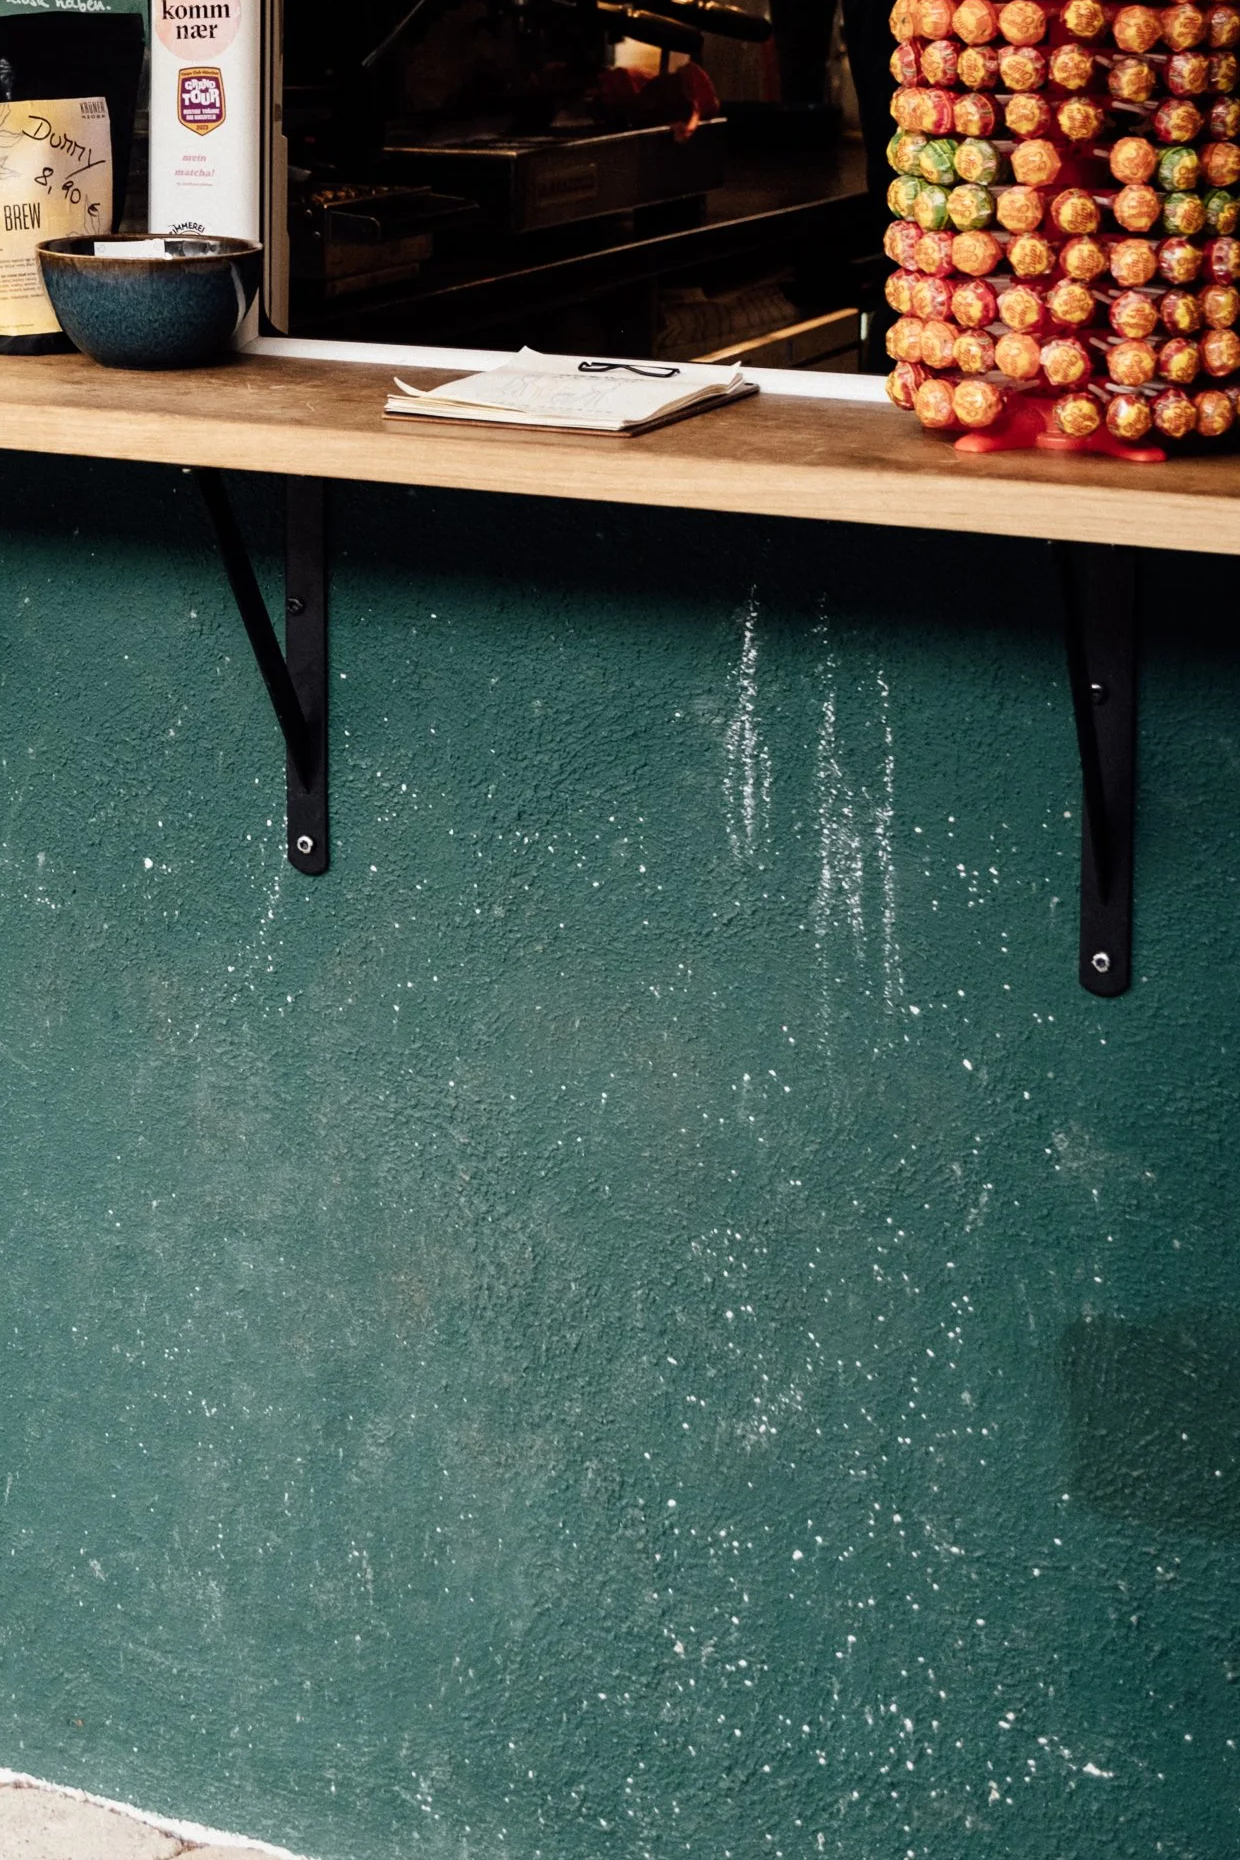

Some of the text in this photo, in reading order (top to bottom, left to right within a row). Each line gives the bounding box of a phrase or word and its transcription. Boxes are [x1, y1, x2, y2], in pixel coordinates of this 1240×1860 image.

[162, 0, 230, 20] komm
[176, 23, 218, 40] nær
[184, 78, 216, 90] GRAND
[182, 88, 220, 108] TOUR
[182, 153, 207, 162] mein
[174, 168, 216, 178] matcha!
[4, 202, 42, 231] BREW
